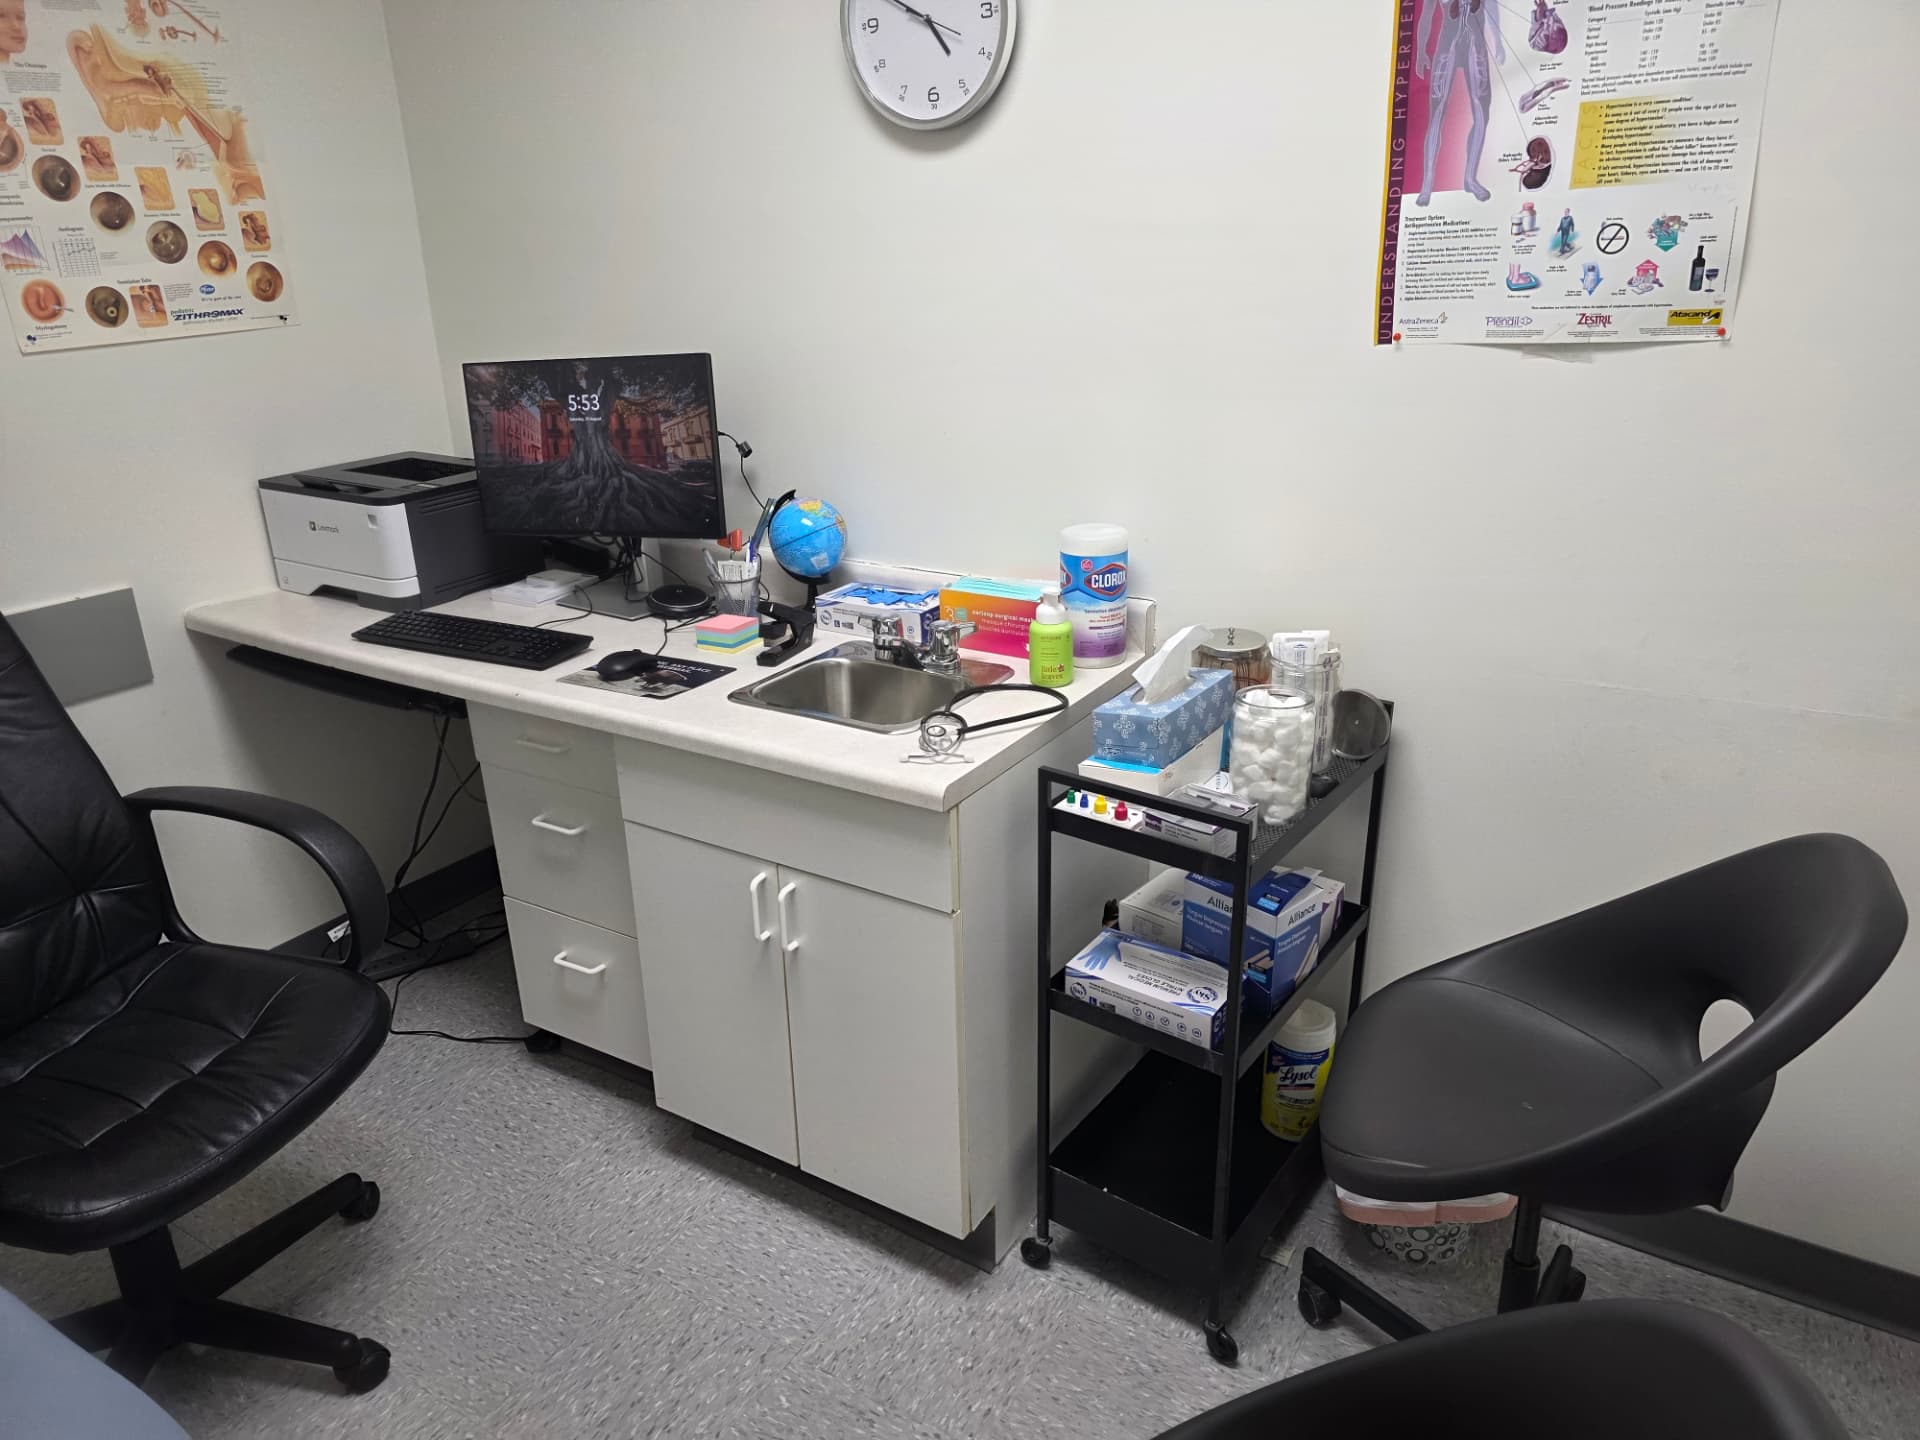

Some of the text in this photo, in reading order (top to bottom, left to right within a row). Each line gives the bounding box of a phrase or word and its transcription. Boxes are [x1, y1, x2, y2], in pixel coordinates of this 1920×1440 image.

[980, 2, 994, 19] 3
[867, 17, 879, 34] 9
[978, 47, 986, 56] 4
[878, 59, 886, 68] 8
[900, 84, 908, 96] 7
[958, 79, 967, 89] 5
[928, 86, 940, 103] 6
[1380, 137, 1405, 342] UNDERSTANDING
[174, 308, 245, 321] ZITHROMAX
[1399, 316, 1439, 325] AstraZeneca
[1577, 313, 1613, 327] ZESTRIL
[1670, 310, 1712, 318] Atacand
[568, 394, 600, 412] 5:53
[1288, 903, 1317, 926] Alliance
[1279, 1065, 1316, 1085] Lysol
